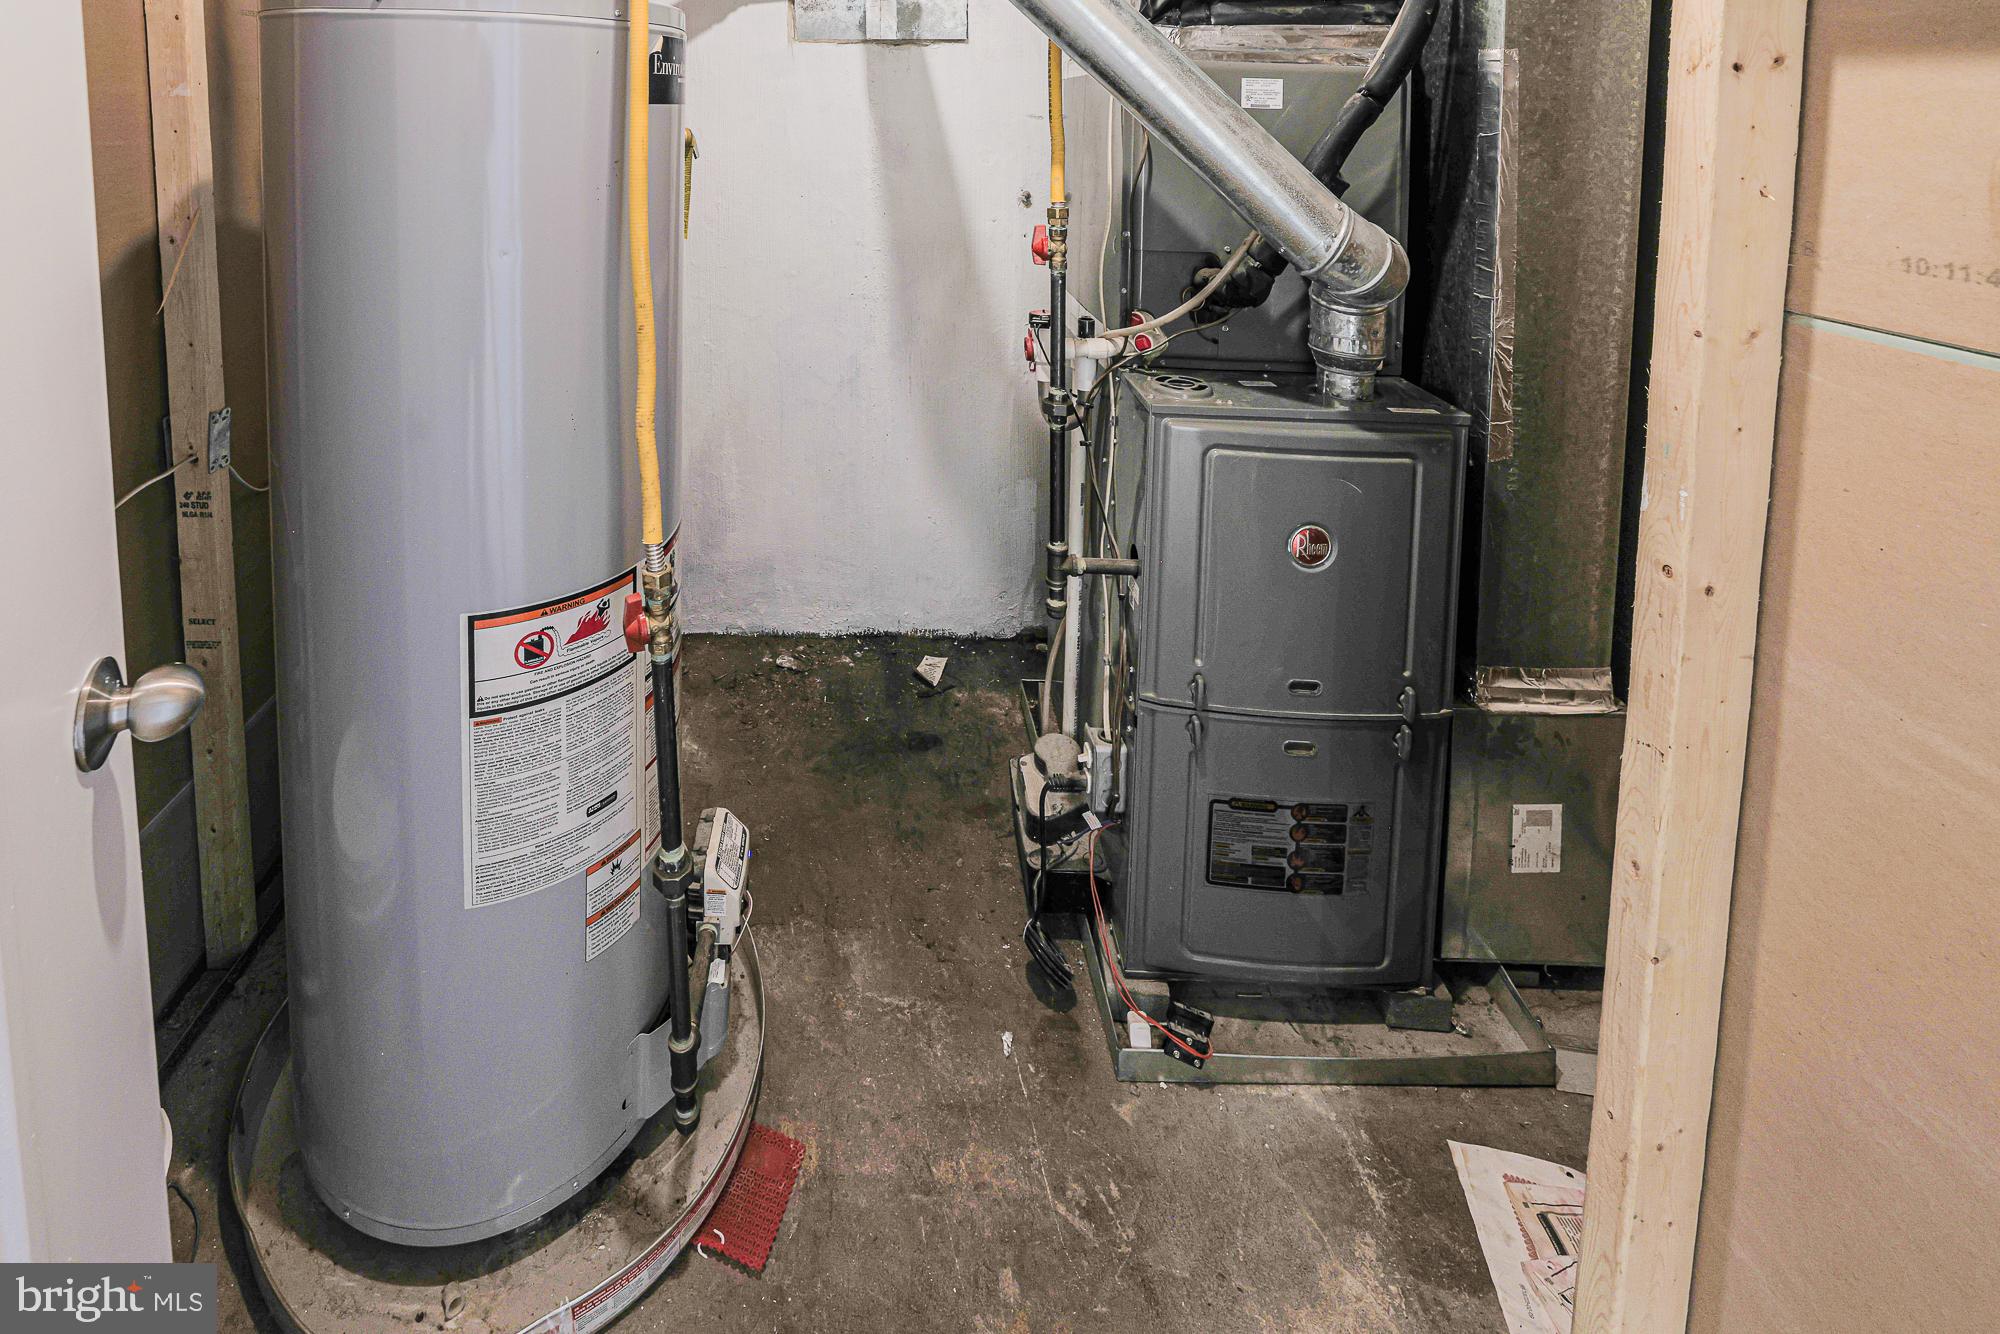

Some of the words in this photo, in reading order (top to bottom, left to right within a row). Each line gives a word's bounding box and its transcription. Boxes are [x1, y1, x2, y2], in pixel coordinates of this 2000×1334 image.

[1295, 529, 1328, 560] Rheem
[549, 598, 586, 614] WARNING
[554, 661, 575, 671] EXPLOSION
[576, 654, 591, 664] HAZARD
